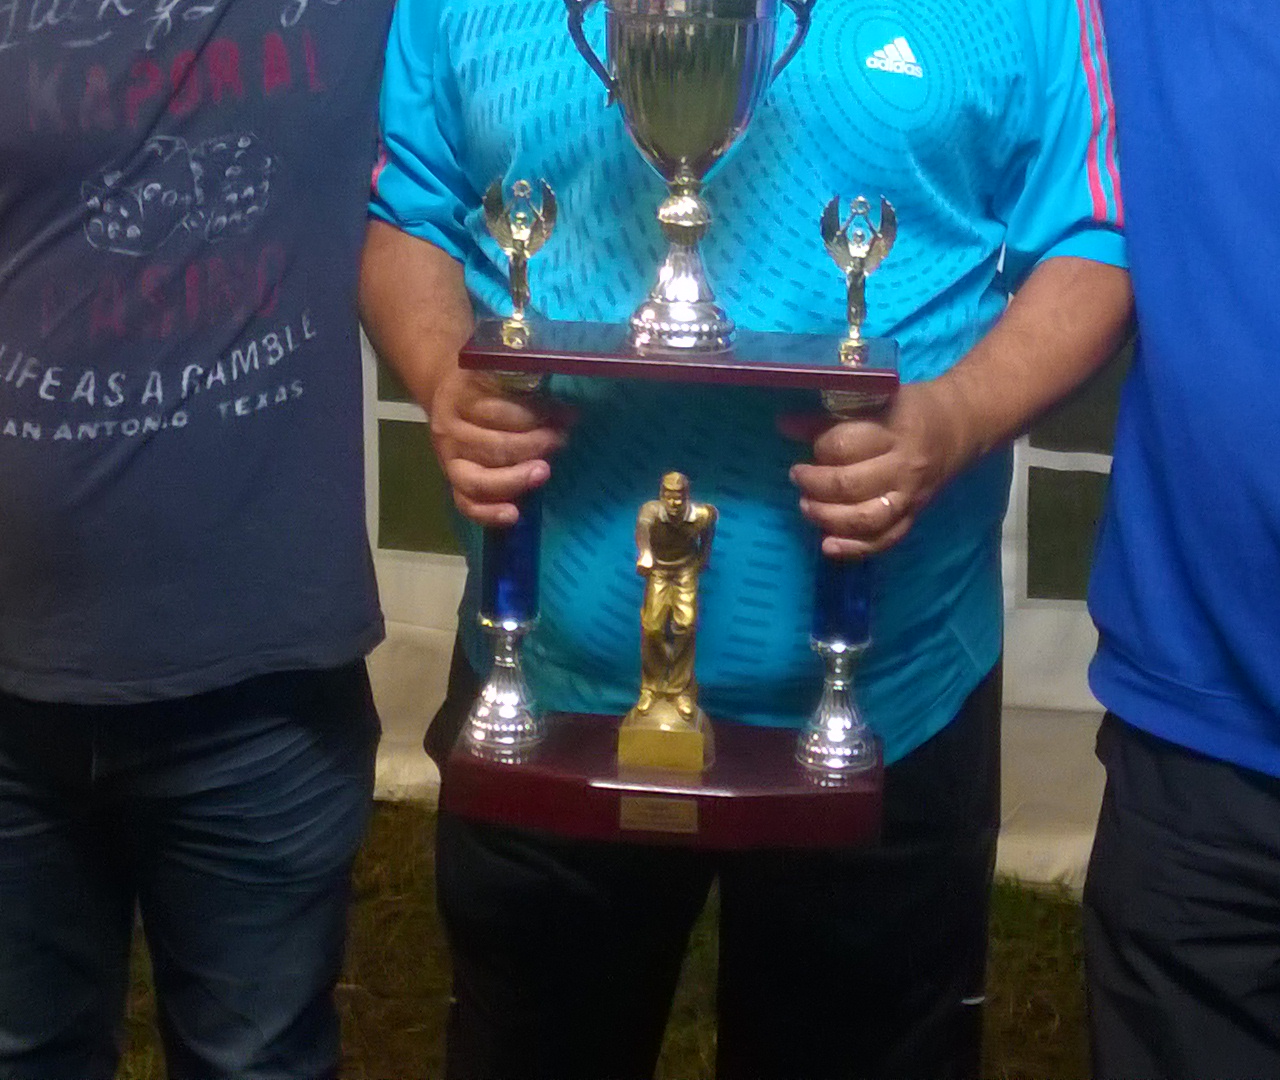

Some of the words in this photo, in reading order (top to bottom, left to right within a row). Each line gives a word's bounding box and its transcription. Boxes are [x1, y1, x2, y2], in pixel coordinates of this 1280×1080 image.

[865, 56, 924, 79] adidas
[72, 370, 126, 408] AS
[141, 370, 164, 405] A
[219, 379, 304, 420] TEXAS
